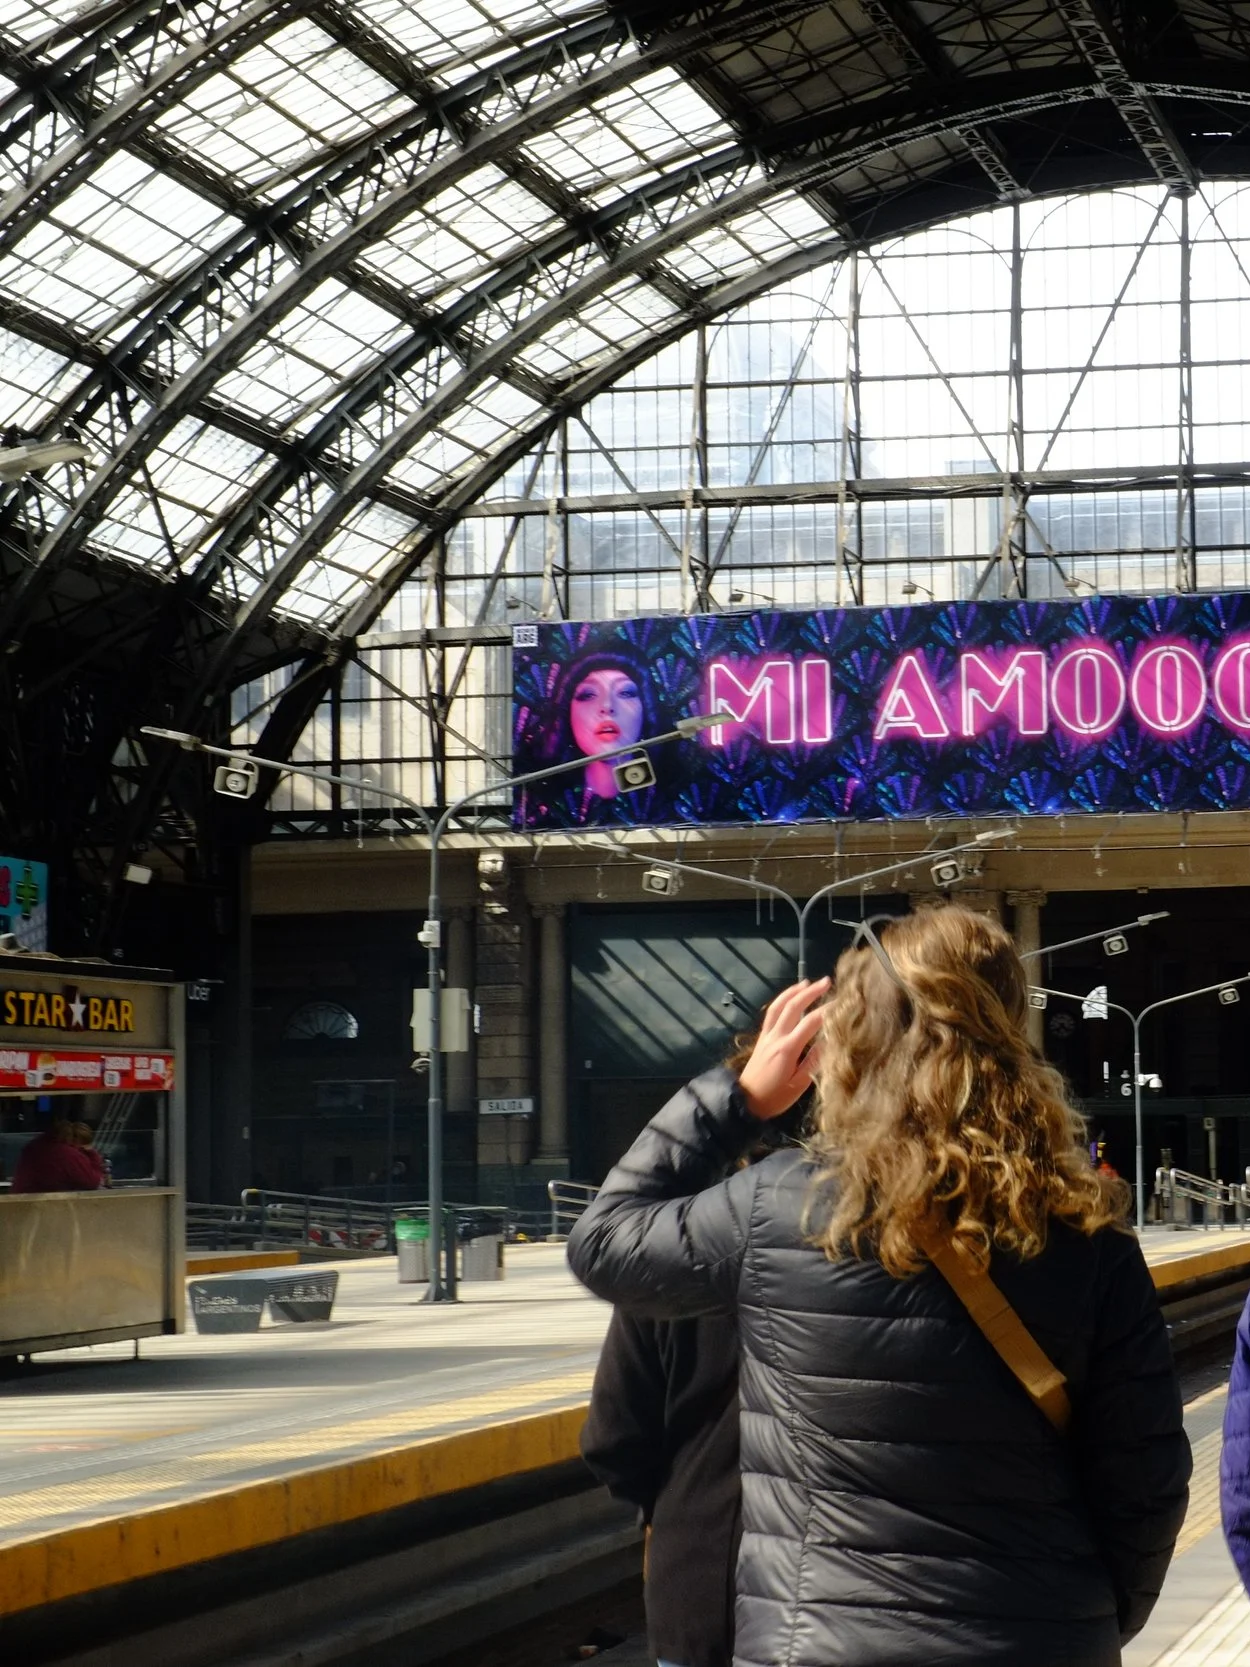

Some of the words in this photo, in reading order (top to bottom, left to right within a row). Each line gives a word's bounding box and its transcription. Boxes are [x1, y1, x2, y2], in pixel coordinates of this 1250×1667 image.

[709, 659, 832, 745] MI
[4, 990, 67, 1028] STAR
[88, 997, 135, 1033] BAR
[1121, 1083, 1132, 1096] 6
[487, 1101, 524, 1112] SALIDA
